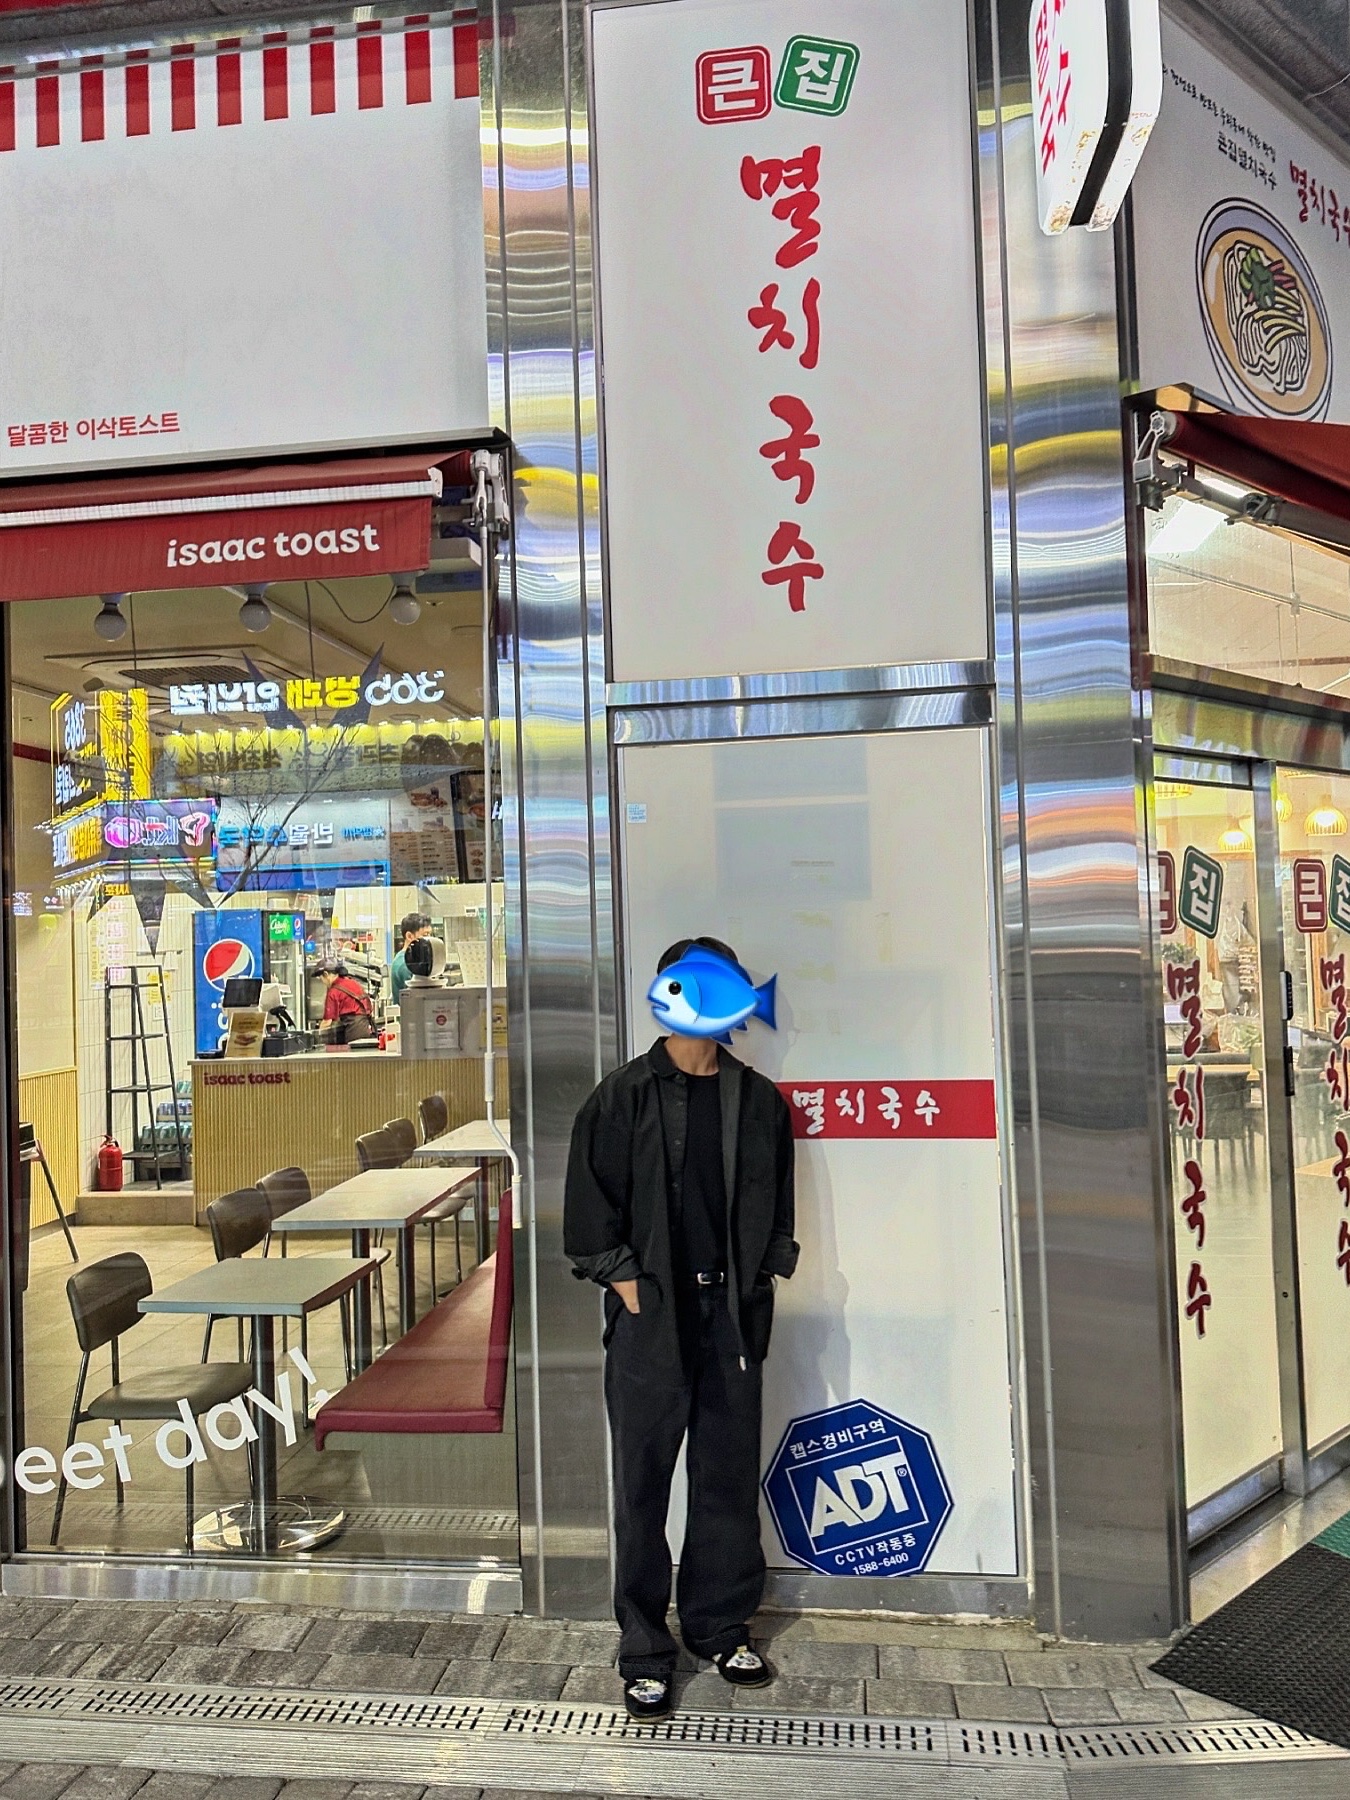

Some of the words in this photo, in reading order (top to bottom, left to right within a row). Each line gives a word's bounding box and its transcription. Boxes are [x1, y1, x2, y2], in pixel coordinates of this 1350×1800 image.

[708, 49, 847, 112] 큰집
[740, 145, 824, 613] 멸치국수
[7, 420, 68, 448] 달콤한
[76, 410, 180, 442] 이삭토스트
[167, 535, 266, 568] isaac
[273, 522, 381, 558] toast
[203, 1072, 245, 1086] isaac
[247, 1070, 291, 1085] toast
[791, 1086, 941, 1135] 멸치국수
[1167, 959, 1212, 1338] 멸치국수
[0, 1425, 133, 1494] eet
[155, 1346, 330, 1470] day!
[789, 1418, 887, 1460] 캡스경비구역
[810, 1450, 909, 1538] ADT
[834, 1532, 917, 1566] CCTV작동중
[852, 1552, 909, 1576] 1588-6400
